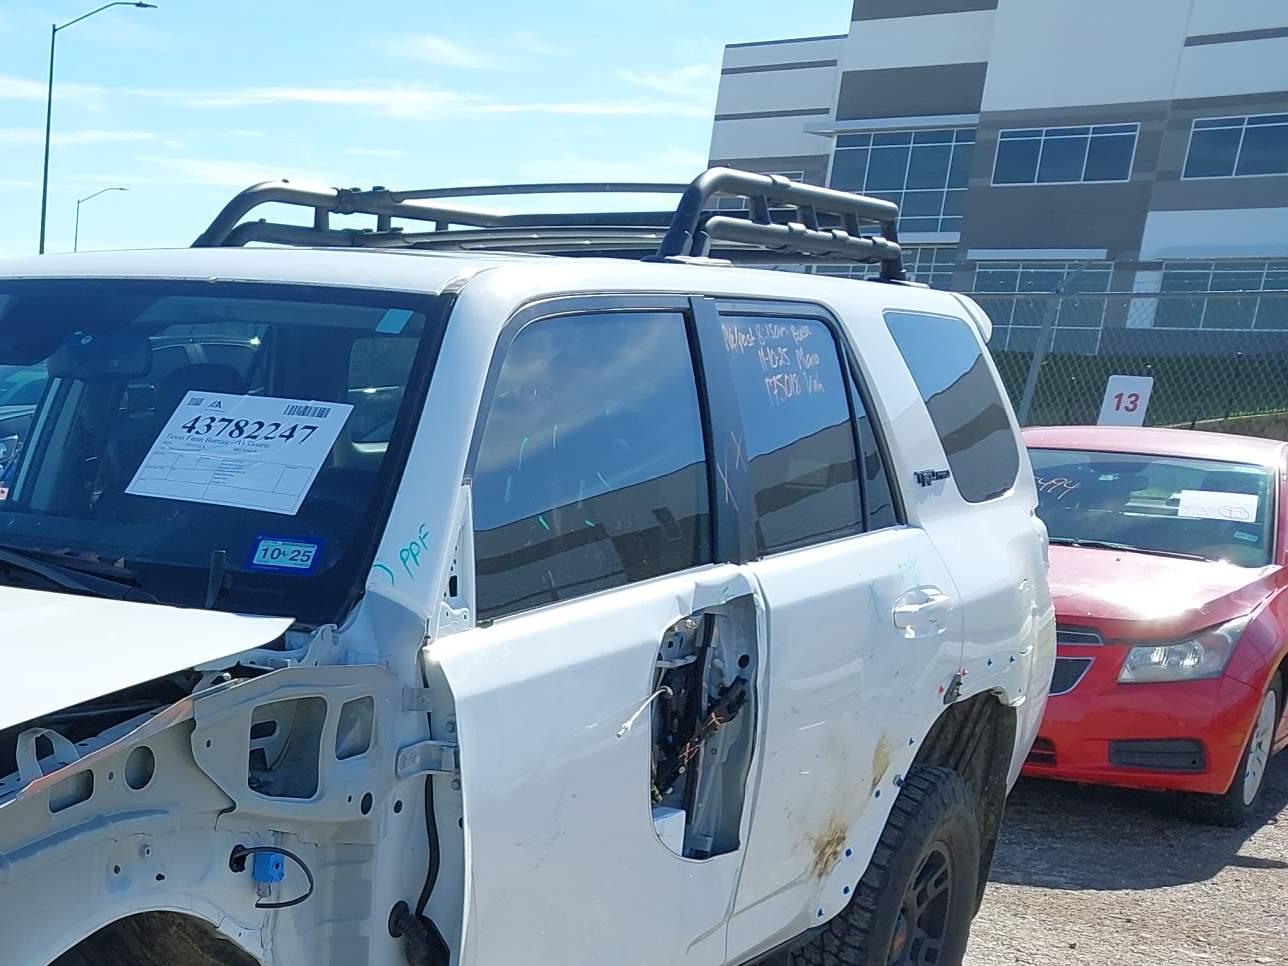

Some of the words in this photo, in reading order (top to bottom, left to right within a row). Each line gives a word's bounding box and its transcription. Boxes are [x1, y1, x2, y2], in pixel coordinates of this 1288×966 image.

[1112, 392, 1140, 413] 13
[181, 415, 320, 446] 43782247
[1034, 476, 1081, 500] 494
[287, 549, 314, 563] 25
